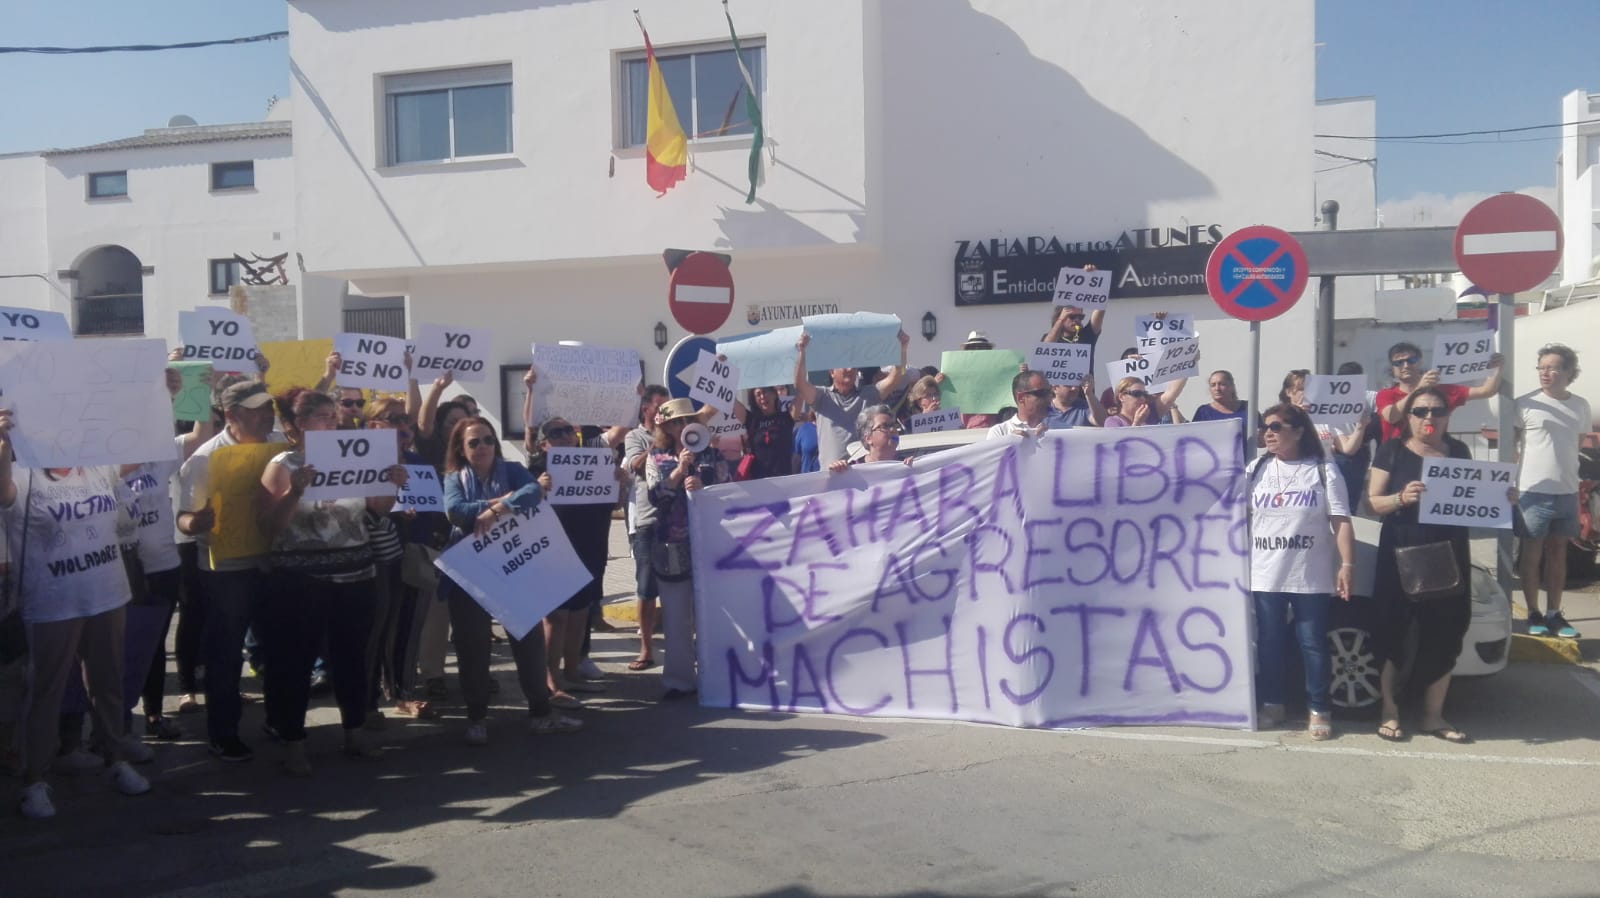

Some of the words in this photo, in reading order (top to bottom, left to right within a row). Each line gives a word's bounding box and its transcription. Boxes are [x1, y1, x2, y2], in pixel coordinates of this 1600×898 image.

[955, 235, 1065, 258] ZAHARA
[1115, 224, 1223, 252] ATUNES
[993, 269, 1056, 295] Entidad
[1119, 264, 1206, 288] Autónom
[1065, 274, 1085, 285] YO
[1089, 276, 1103, 288] SI
[1057, 291, 1073, 301] TE
[1076, 292, 1107, 303] CREO
[761, 303, 839, 321] AYUNTAMIENTO
[2, 312, 39, 329] YO
[208, 320, 240, 336] YO
[1142, 320, 1163, 332] YO
[1169, 320, 1184, 331] SI
[357, 339, 387, 355] NO
[445, 332, 471, 349] YO
[1141, 338, 1156, 347] TE
[1444, 342, 1469, 356] YO
[1475, 339, 1490, 353] SI
[184, 345, 257, 360] DECIDO
[1035, 347, 1071, 357] BASTA
[1075, 349, 1088, 358] YA
[1167, 346, 1183, 360] YO
[1185, 344, 1198, 356] SI
[341, 360, 367, 376] ES
[373, 363, 403, 380] NO
[417, 356, 484, 372] DECIDO
[711, 360, 730, 378] NO
[1052, 360, 1068, 369] DE
[1126, 359, 1149, 374] NO
[1156, 366, 1168, 378] TE
[1169, 360, 1195, 374] CREO
[1437, 365, 1456, 375] TE
[1046, 370, 1083, 381] BUSOS
[695, 376, 714, 394] ES
[717, 386, 734, 403] NO
[1329, 381, 1351, 395] YO
[1309, 403, 1363, 415] DECIDO
[914, 414, 946, 428] BASTA
[949, 411, 960, 421] YA
[337, 438, 371, 458] YO
[552, 454, 599, 466] BASTA
[311, 469, 392, 487] DECIDO
[414, 470, 434, 480] YA
[574, 470, 594, 481] DE
[1428, 465, 1482, 481] BASTA
[1490, 470, 1511, 483] YA
[555, 485, 612, 497] ABUSOS
[1452, 486, 1475, 498] DE
[397, 495, 438, 506] USOS
[1430, 503, 1500, 519] ABUSOS
[472, 517, 519, 553] BASTA
[522, 506, 541, 522] YA
[502, 534, 523, 555] DE
[1254, 534, 1315, 551] VIOLADORES
[502, 536, 551, 576] ABUSOS
[871, 512, 1250, 612] AGRESORES
[762, 562, 849, 633] DE
[726, 603, 1234, 714] MACHISTAS
